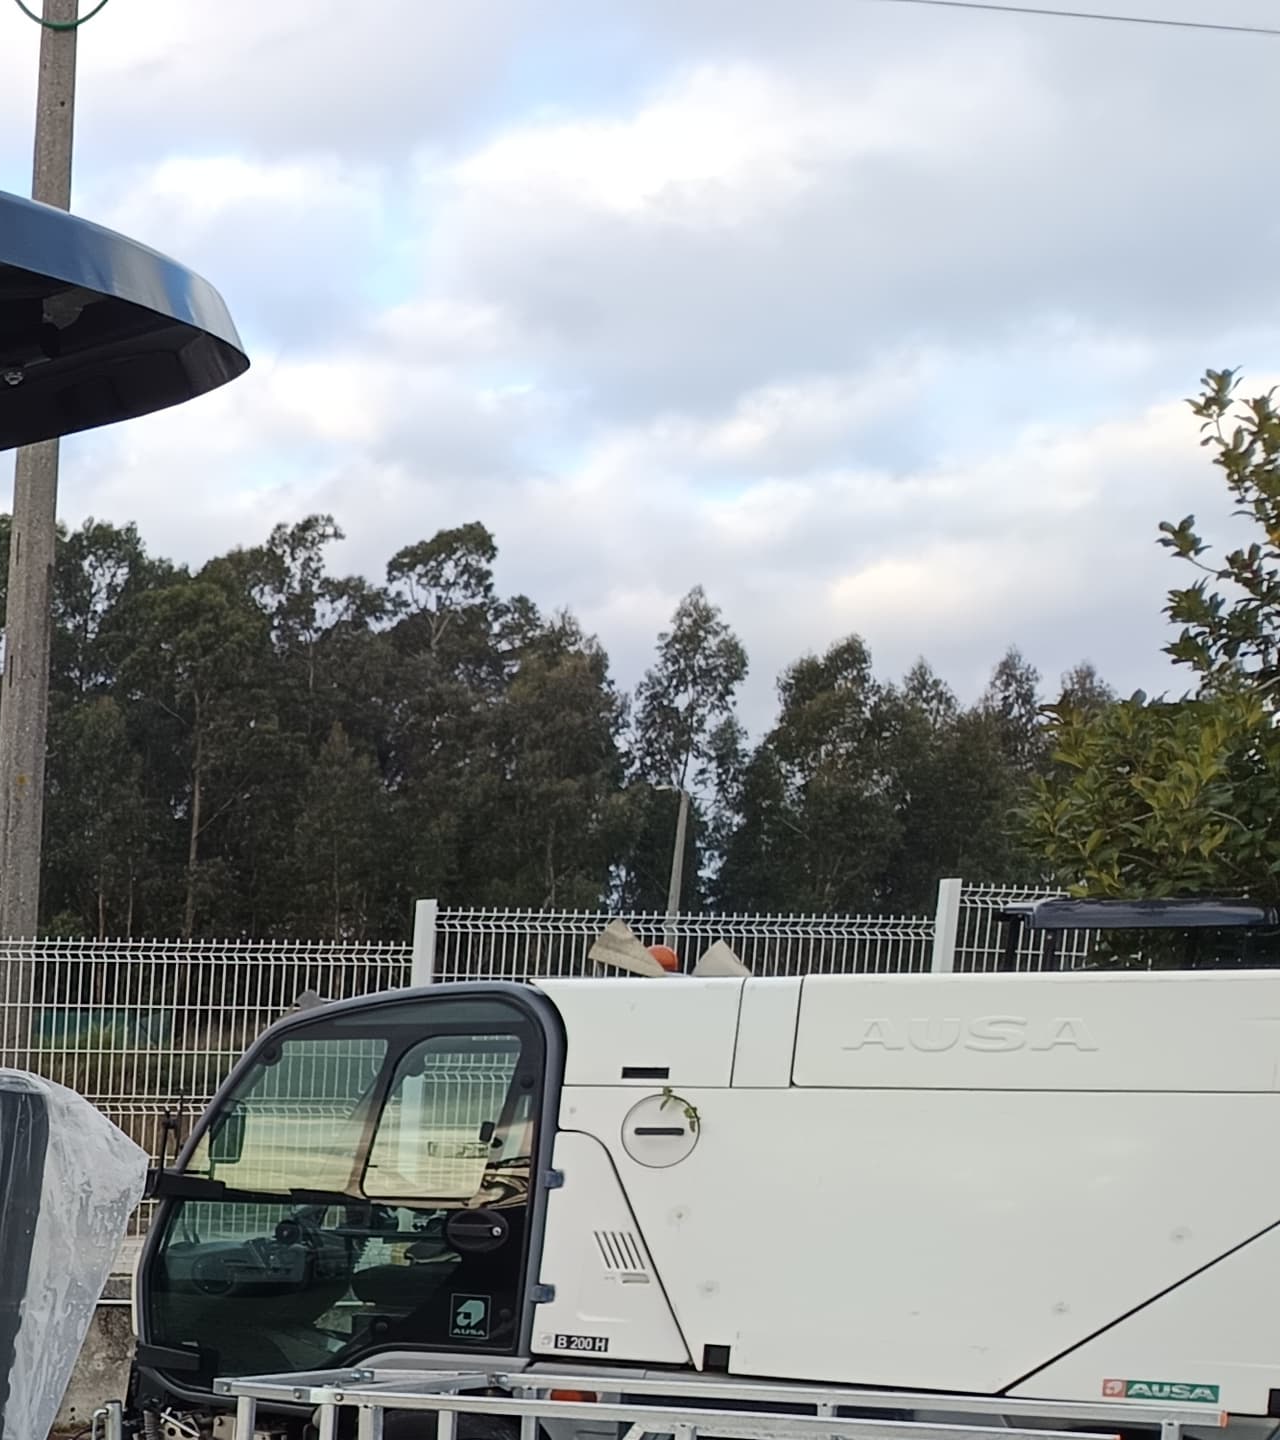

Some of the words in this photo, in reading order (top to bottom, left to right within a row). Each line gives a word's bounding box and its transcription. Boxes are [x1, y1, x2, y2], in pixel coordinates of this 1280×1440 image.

[842, 1015, 1099, 1052] AUSA
[452, 1328, 486, 1336] AUSA
[557, 1336, 567, 1348] B
[570, 1337, 593, 1350] 200
[596, 1339, 606, 1351] H
[1127, 1383, 1216, 1400] AUSA
